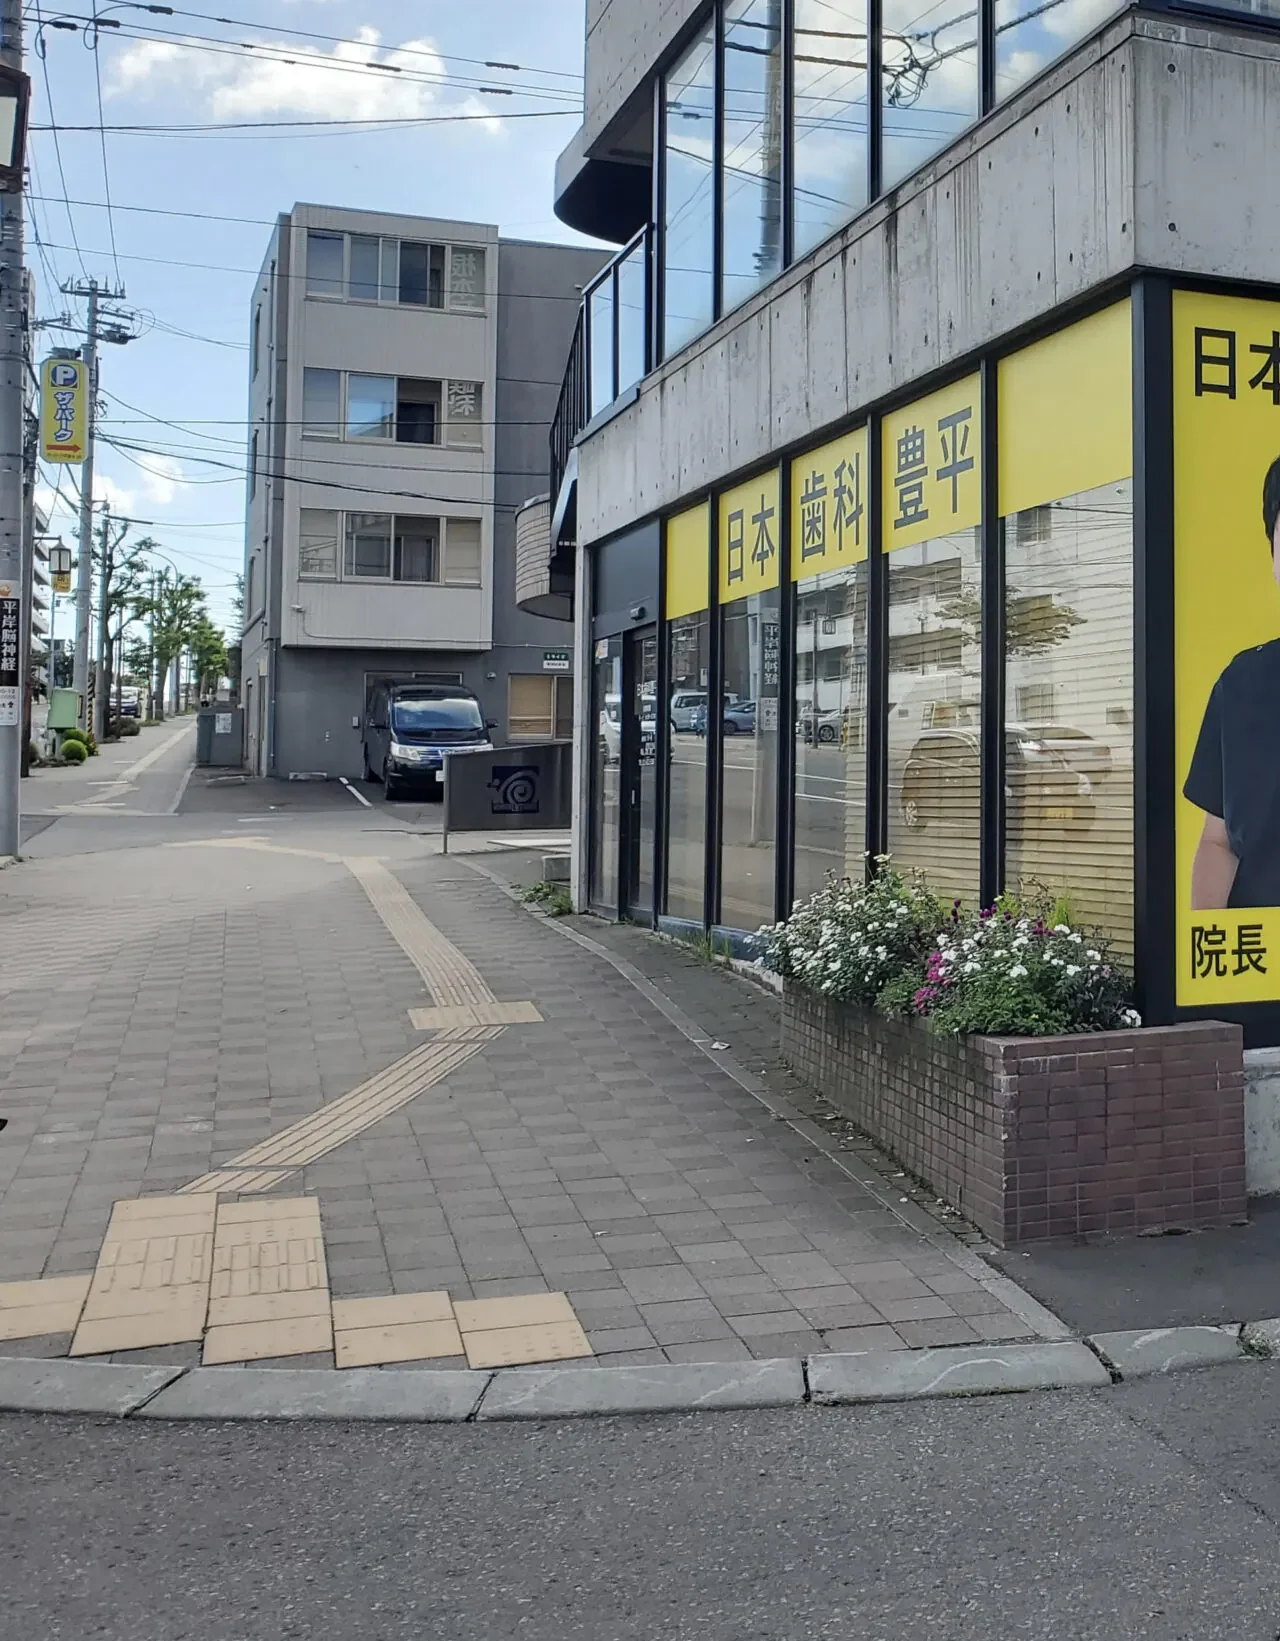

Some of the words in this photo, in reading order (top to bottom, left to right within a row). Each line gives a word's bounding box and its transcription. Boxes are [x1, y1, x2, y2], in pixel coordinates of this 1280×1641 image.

[56, 364, 75, 385] P
[893, 406, 975, 530] 豊平
[1191, 924, 1267, 979] 院長
